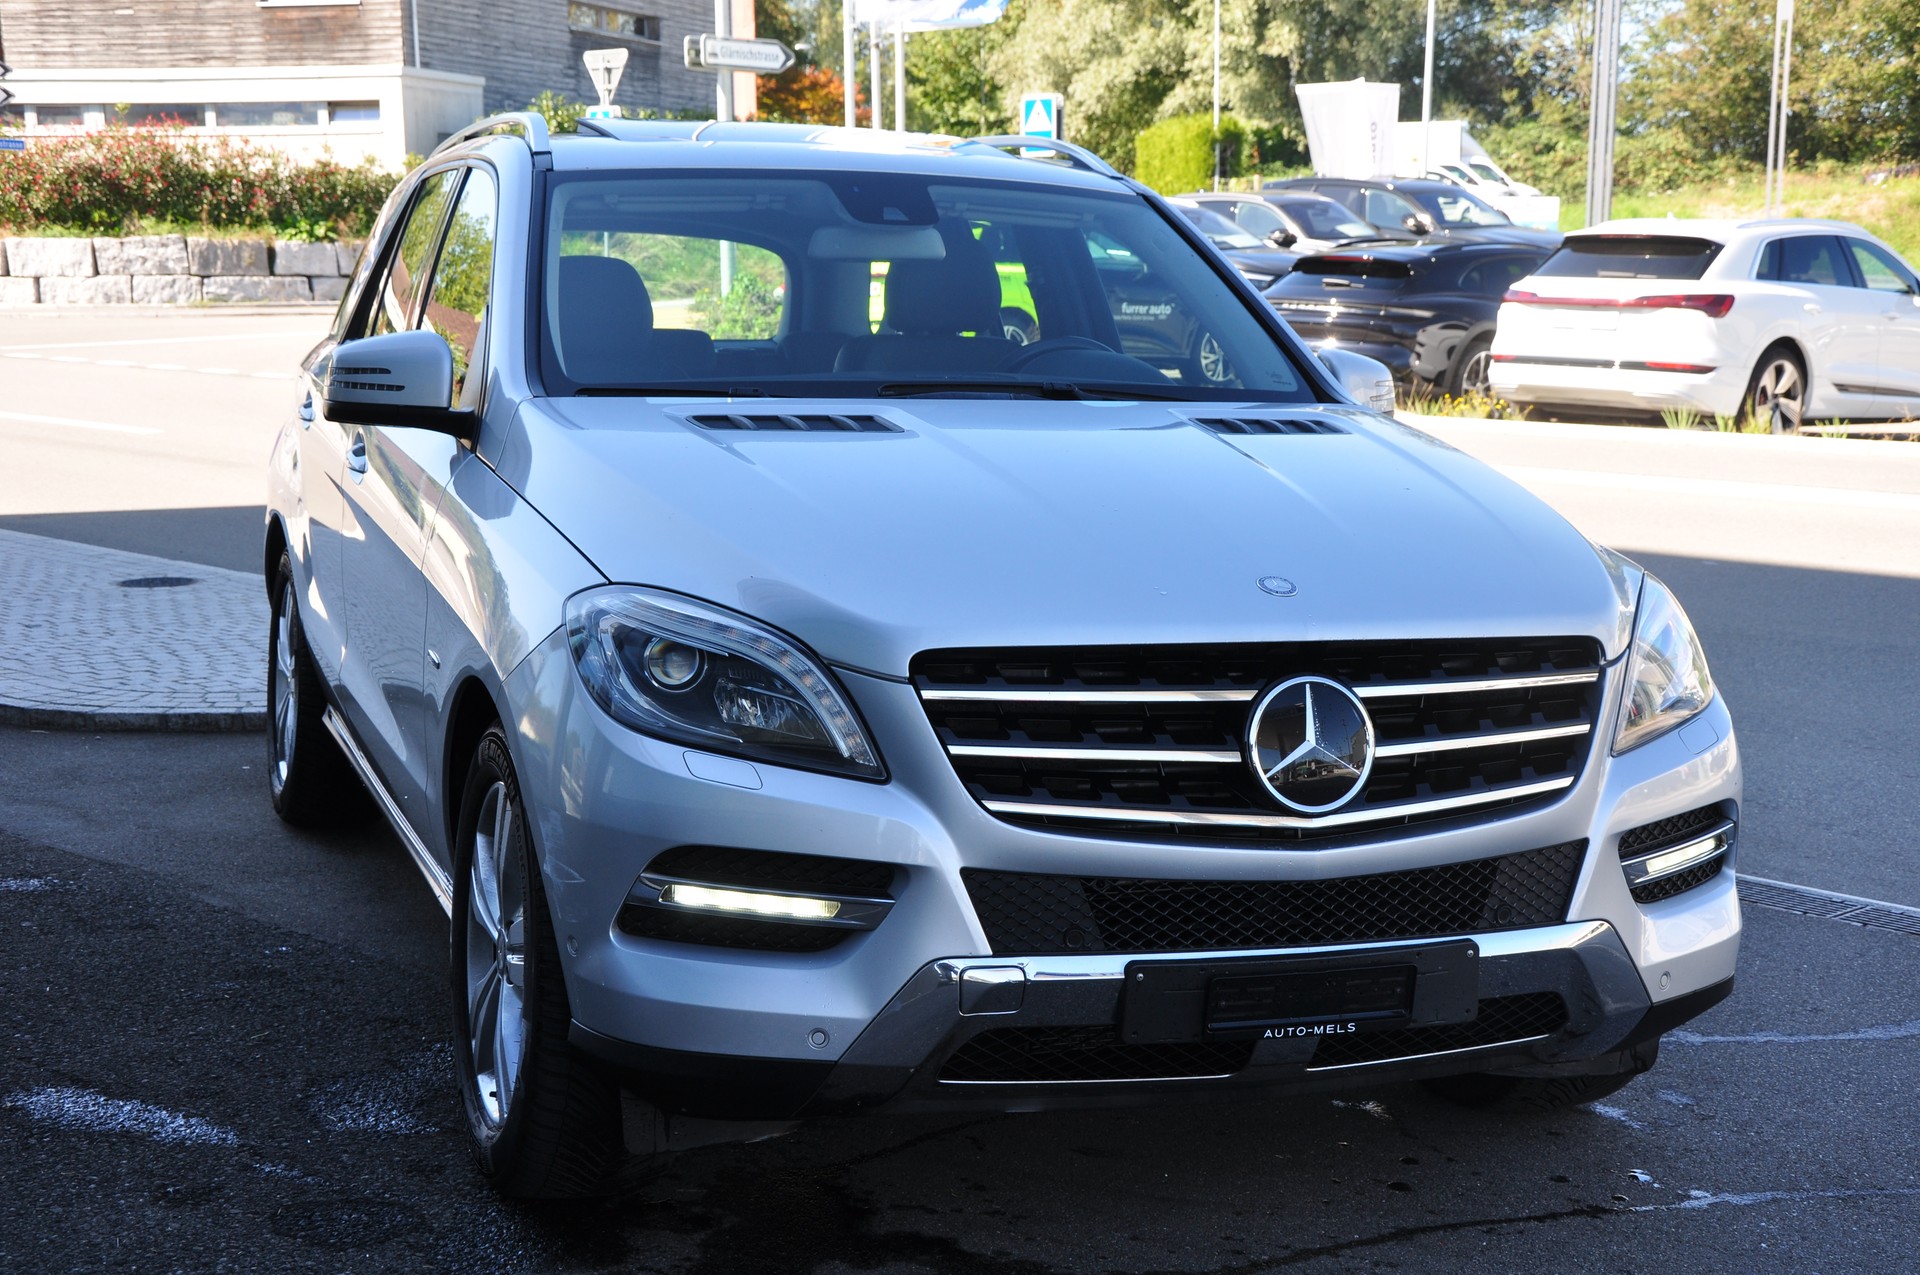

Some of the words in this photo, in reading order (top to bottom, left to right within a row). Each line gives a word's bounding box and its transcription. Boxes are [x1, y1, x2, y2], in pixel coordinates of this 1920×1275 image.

[1121, 301, 1148, 315] furrer
[1149, 303, 1172, 315] auto
[489, 742, 516, 800] MICHELIN
[1263, 1022, 1356, 1038] AUTO-MELS
